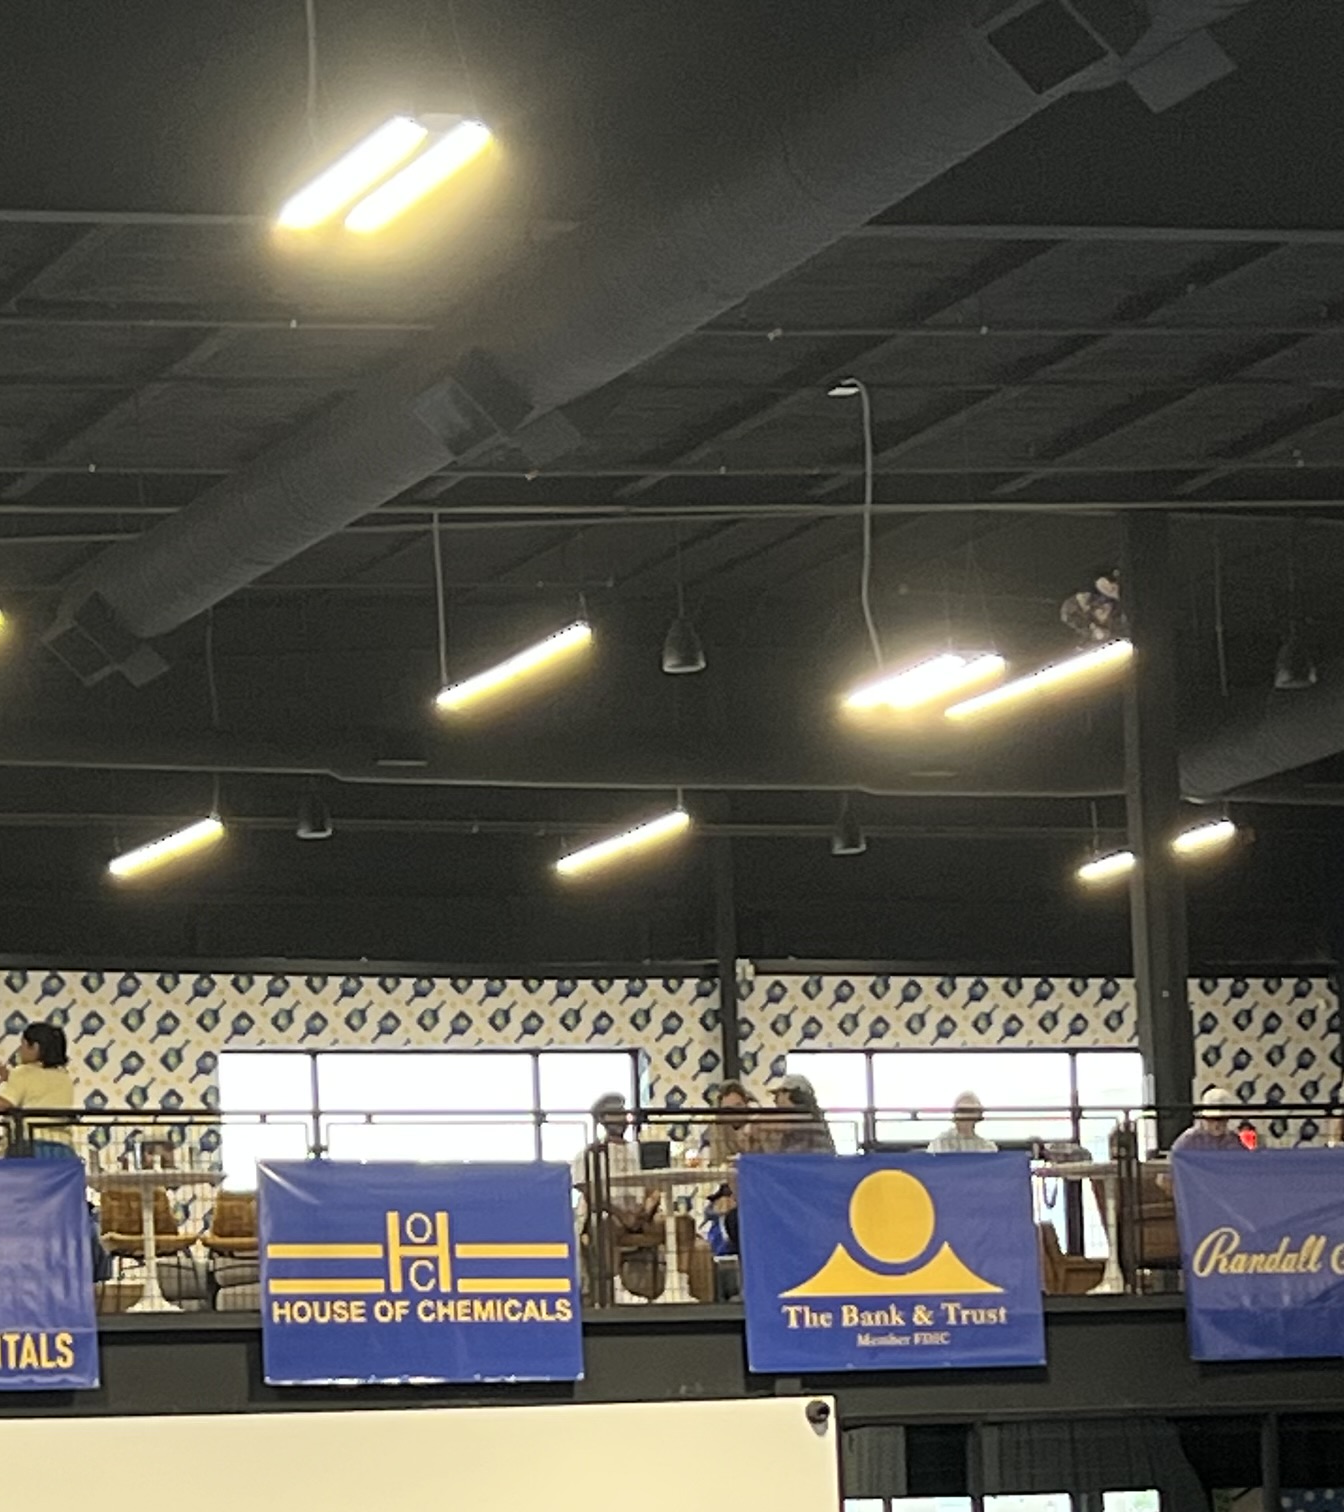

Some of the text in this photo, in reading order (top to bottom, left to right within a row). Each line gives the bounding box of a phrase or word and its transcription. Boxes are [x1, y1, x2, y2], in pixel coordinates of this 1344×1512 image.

[1193, 1227, 1327, 1278] Randall
[271, 1299, 573, 1323] HOUSE OF CHEMICALS
[782, 1302, 1008, 1329] The Bank & Trust
[857, 1332, 911, 1347] Member
